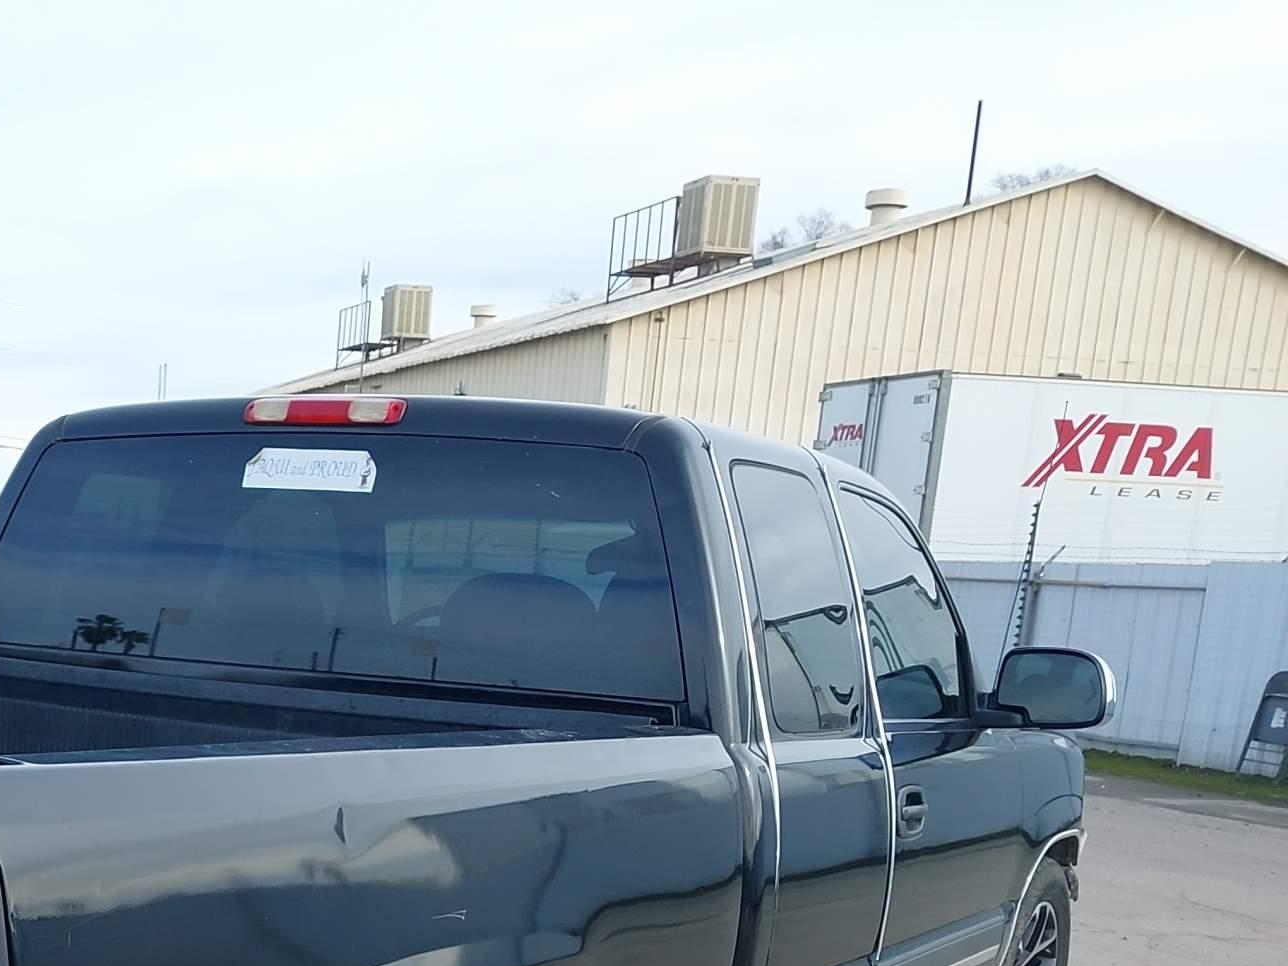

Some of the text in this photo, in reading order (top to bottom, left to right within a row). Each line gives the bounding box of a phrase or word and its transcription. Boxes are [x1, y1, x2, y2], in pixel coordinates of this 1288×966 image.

[827, 423, 864, 447] XTRA
[1022, 413, 1214, 488] XTRA
[309, 459, 358, 479] PROUD
[1089, 485, 1222, 502] LEASE
